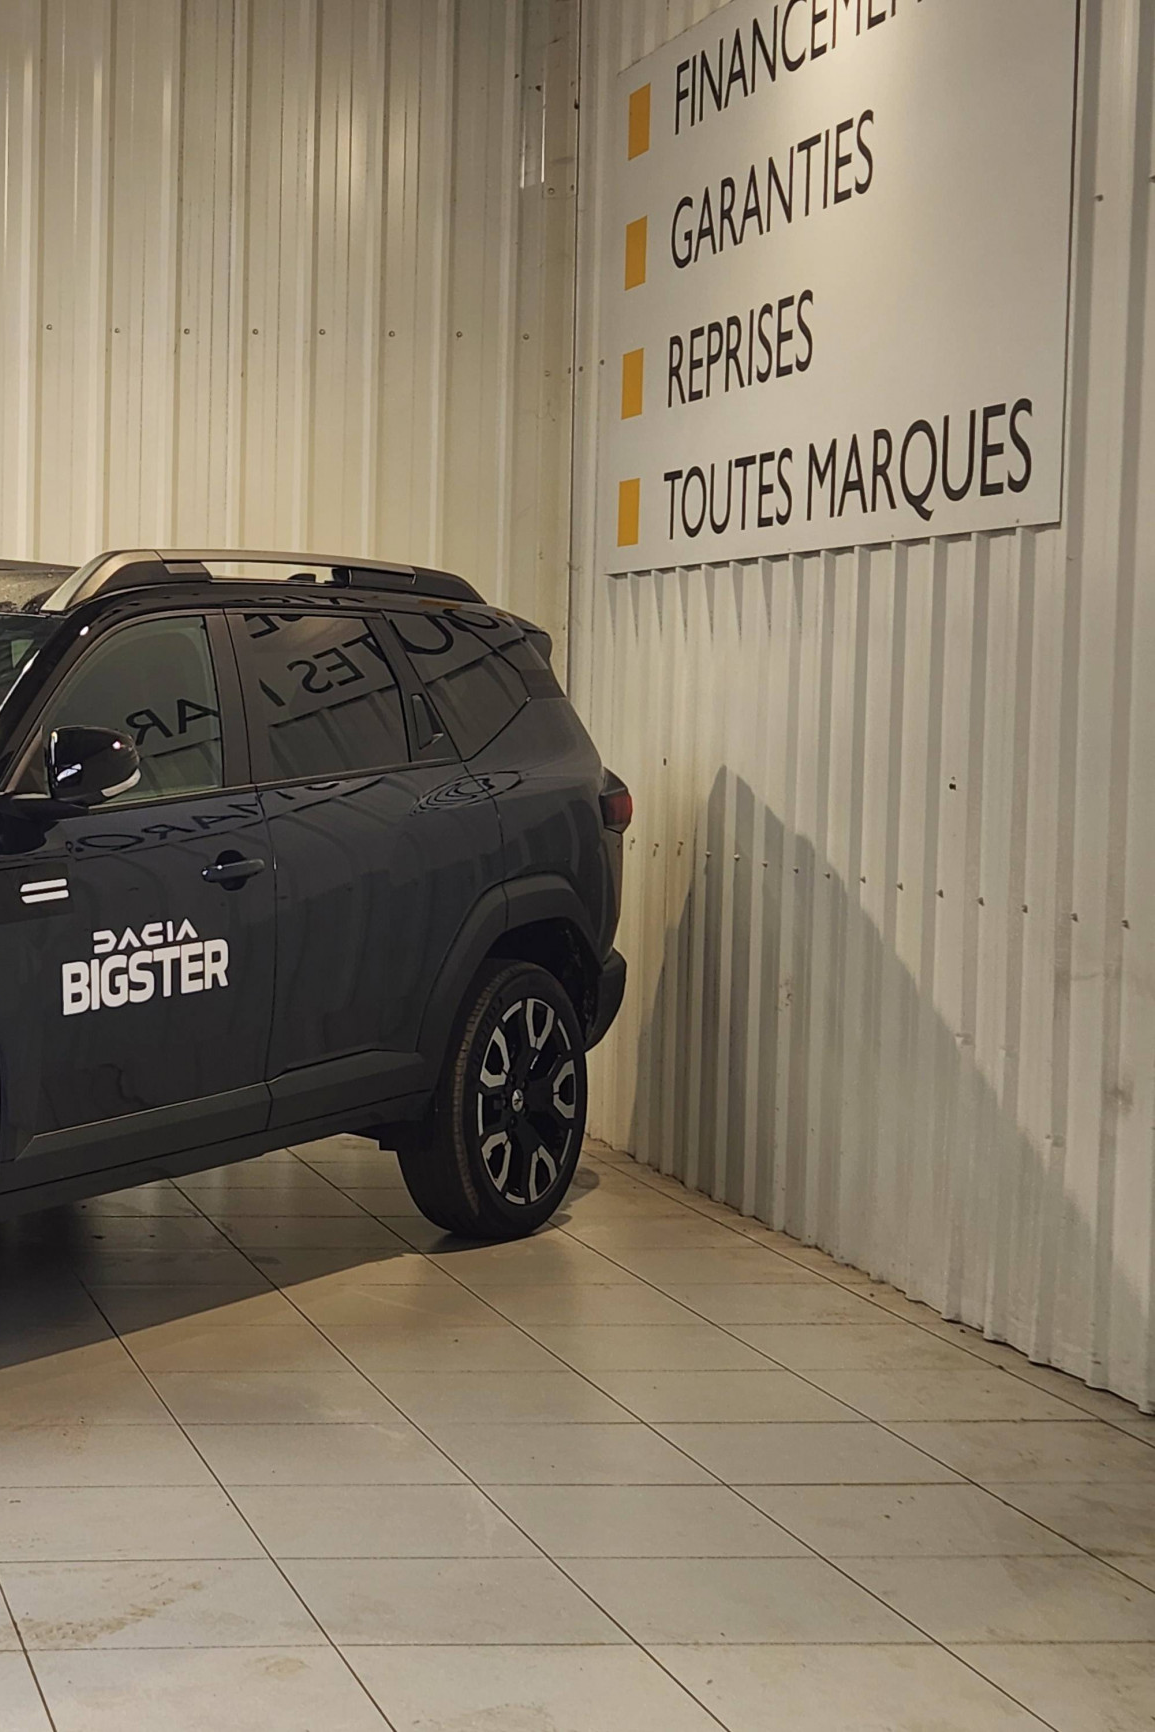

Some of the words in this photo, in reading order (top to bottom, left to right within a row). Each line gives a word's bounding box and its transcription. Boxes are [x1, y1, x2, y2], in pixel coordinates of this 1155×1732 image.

[671, 109, 874, 269] GARANTIES
[667, 289, 814, 408] REPRISES
[663, 447, 793, 540] TOUTES
[806, 398, 1033, 522] MARQUES
[62, 938, 229, 1016] BIGSTER
[93, 918, 198, 954] DACIA
